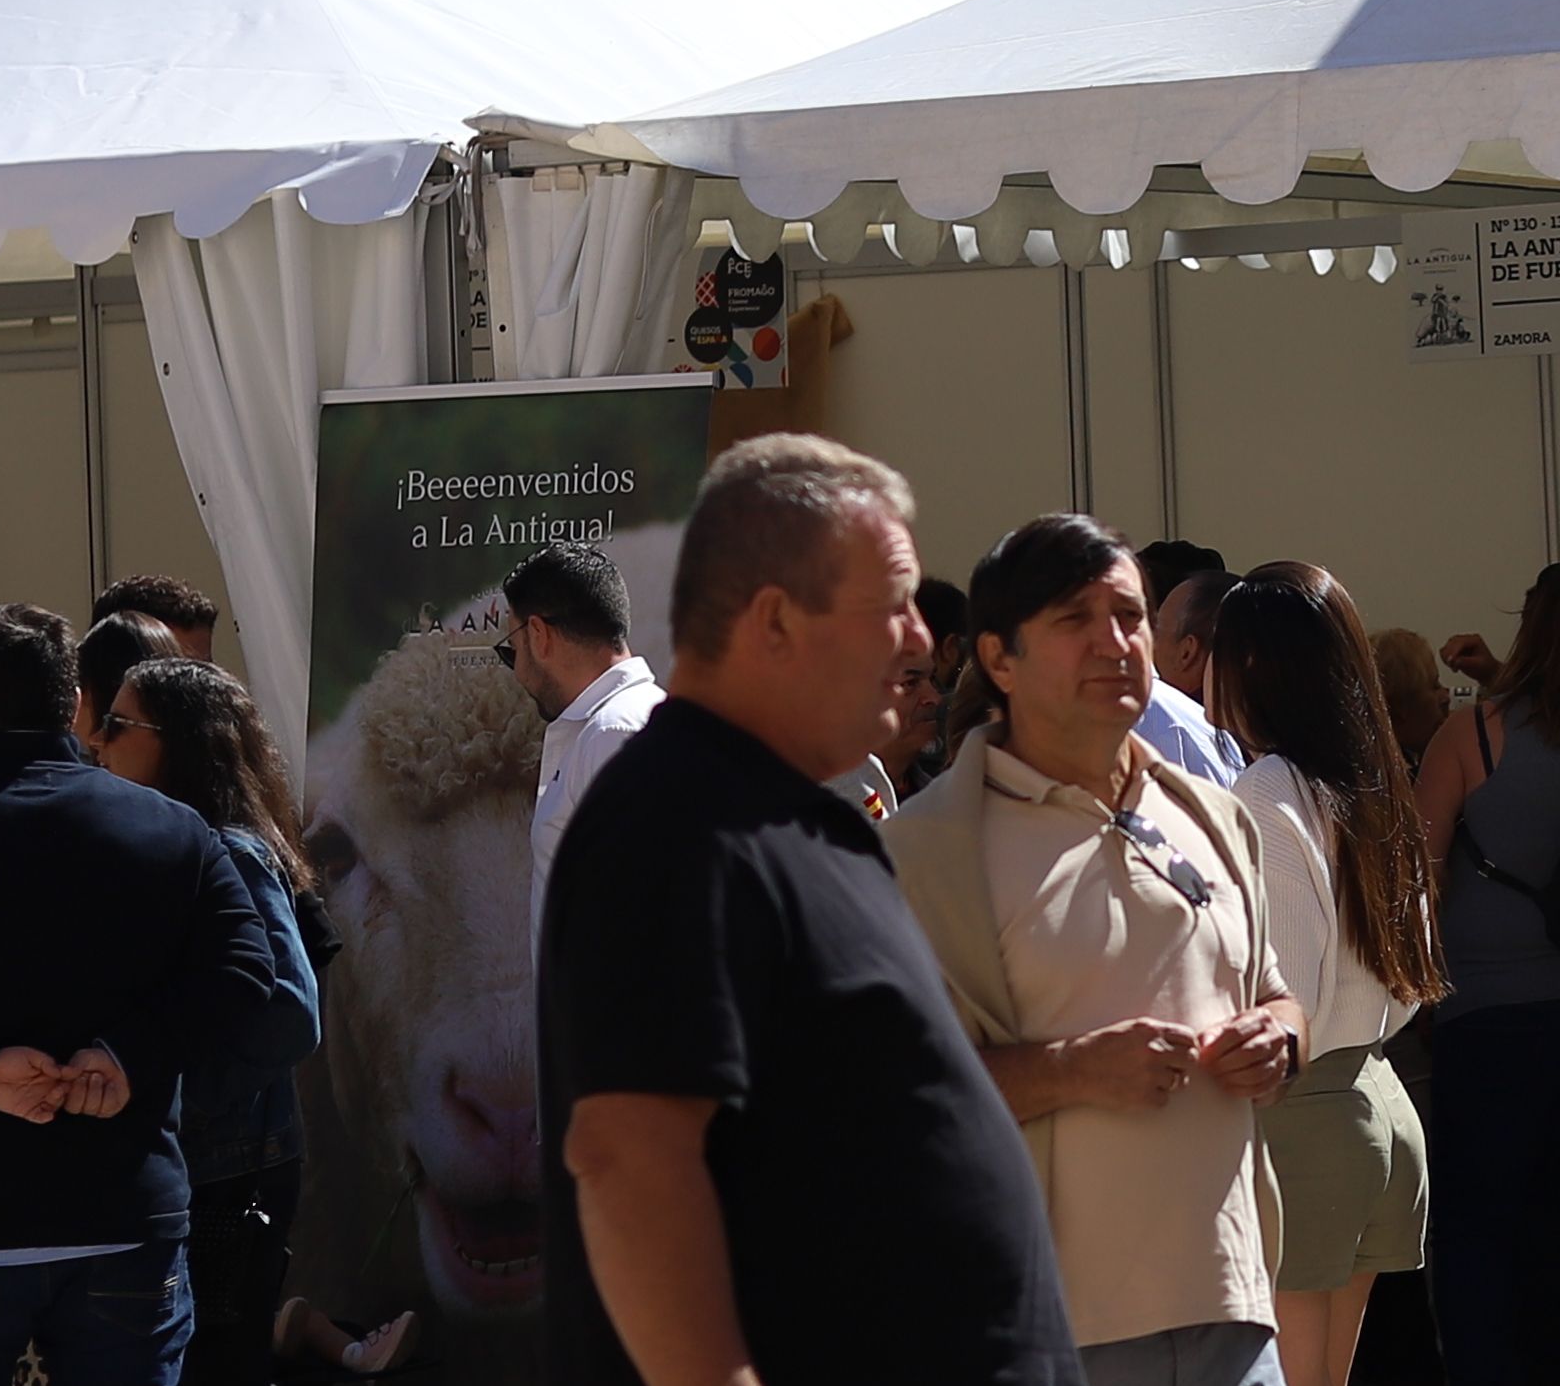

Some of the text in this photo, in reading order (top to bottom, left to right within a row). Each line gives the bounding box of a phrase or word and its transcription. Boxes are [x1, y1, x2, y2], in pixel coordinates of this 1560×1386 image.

[1491, 219, 1510, 233] Nº
[1513, 217, 1537, 232] 130
[1490, 239, 1518, 259] LA
[1492, 263, 1520, 282] DE
[1494, 332, 1552, 347] ZAMORA
[396, 463, 635, 511] ¡Beeeenvenidos
[411, 510, 615, 549] a La Antigua!
